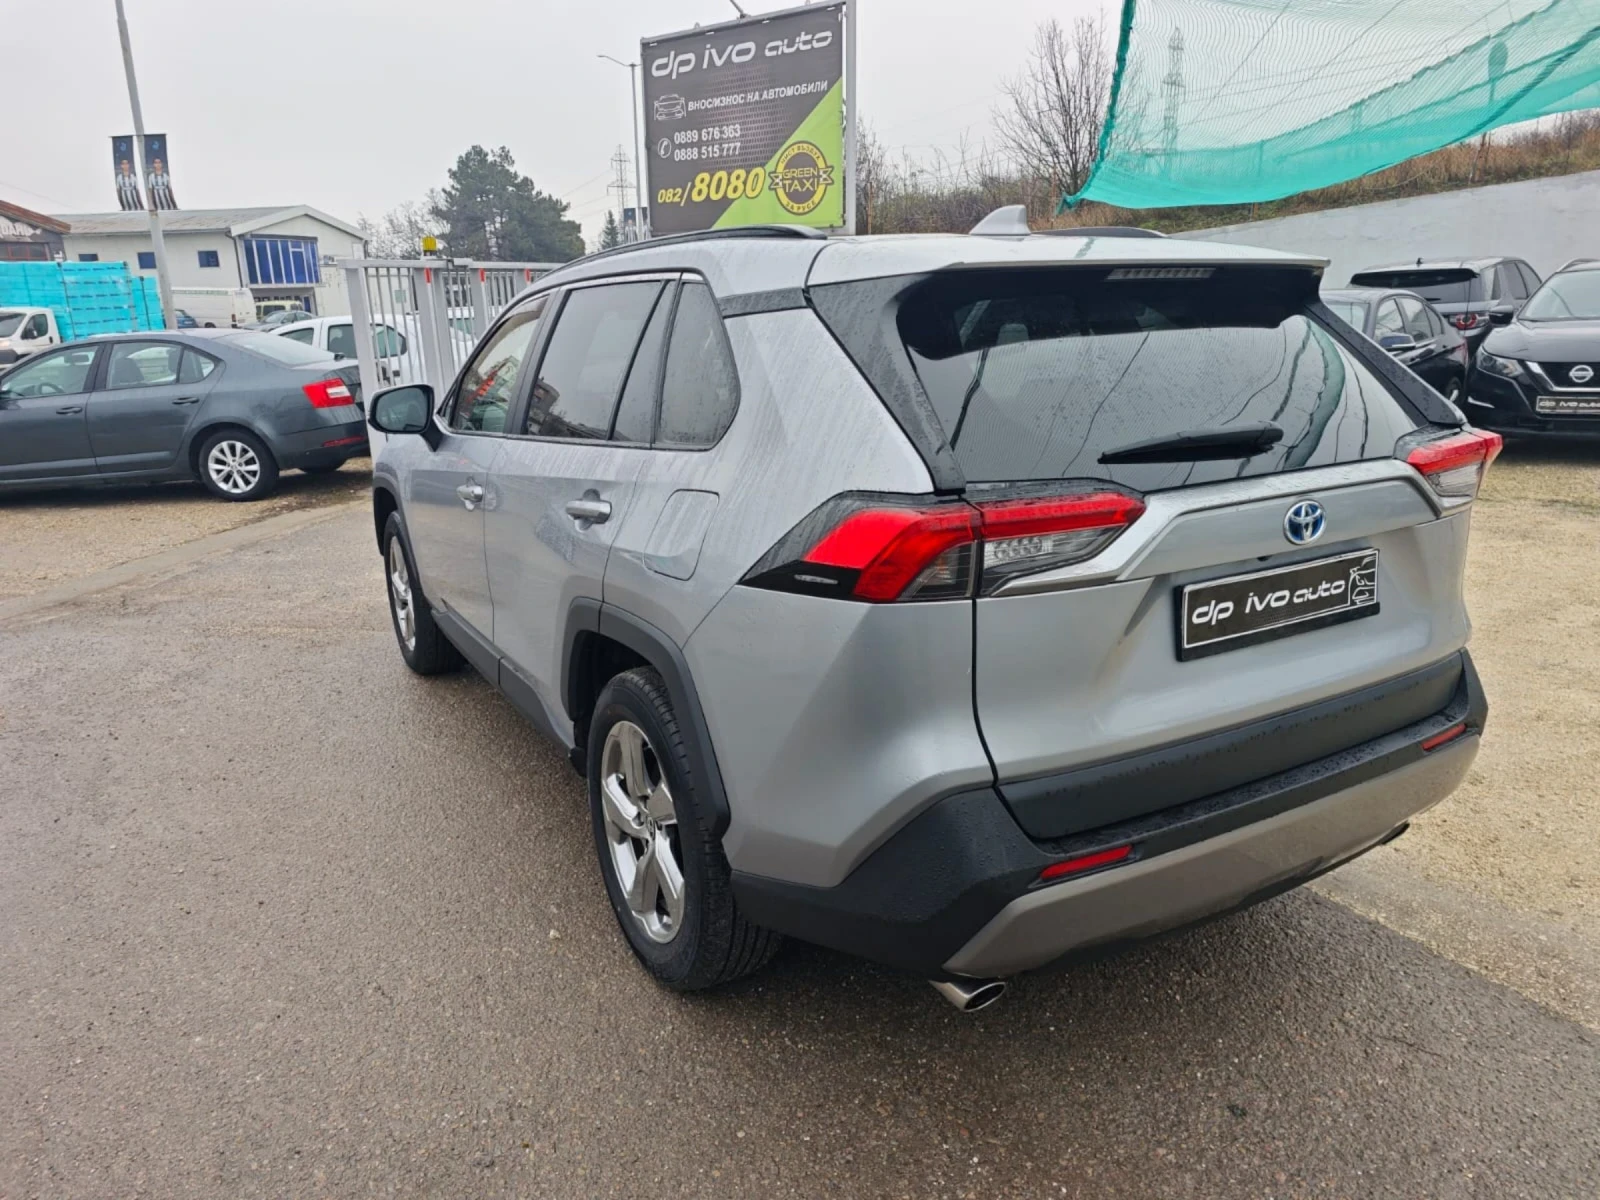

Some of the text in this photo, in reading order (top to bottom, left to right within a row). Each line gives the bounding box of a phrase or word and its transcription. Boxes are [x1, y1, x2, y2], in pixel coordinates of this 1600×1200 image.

[651, 31, 833, 79] dp ivo auto
[688, 80, 828, 111] ВНОС/ИЗНОС НА АВТОМОБИЛИ
[674, 124, 741, 144] 0889 676 363
[674, 142, 741, 161] 0888 515 777
[783, 167, 818, 178] GREEN
[783, 178, 818, 192] TAXI
[1191, 579, 1346, 625] dp ivo auto
